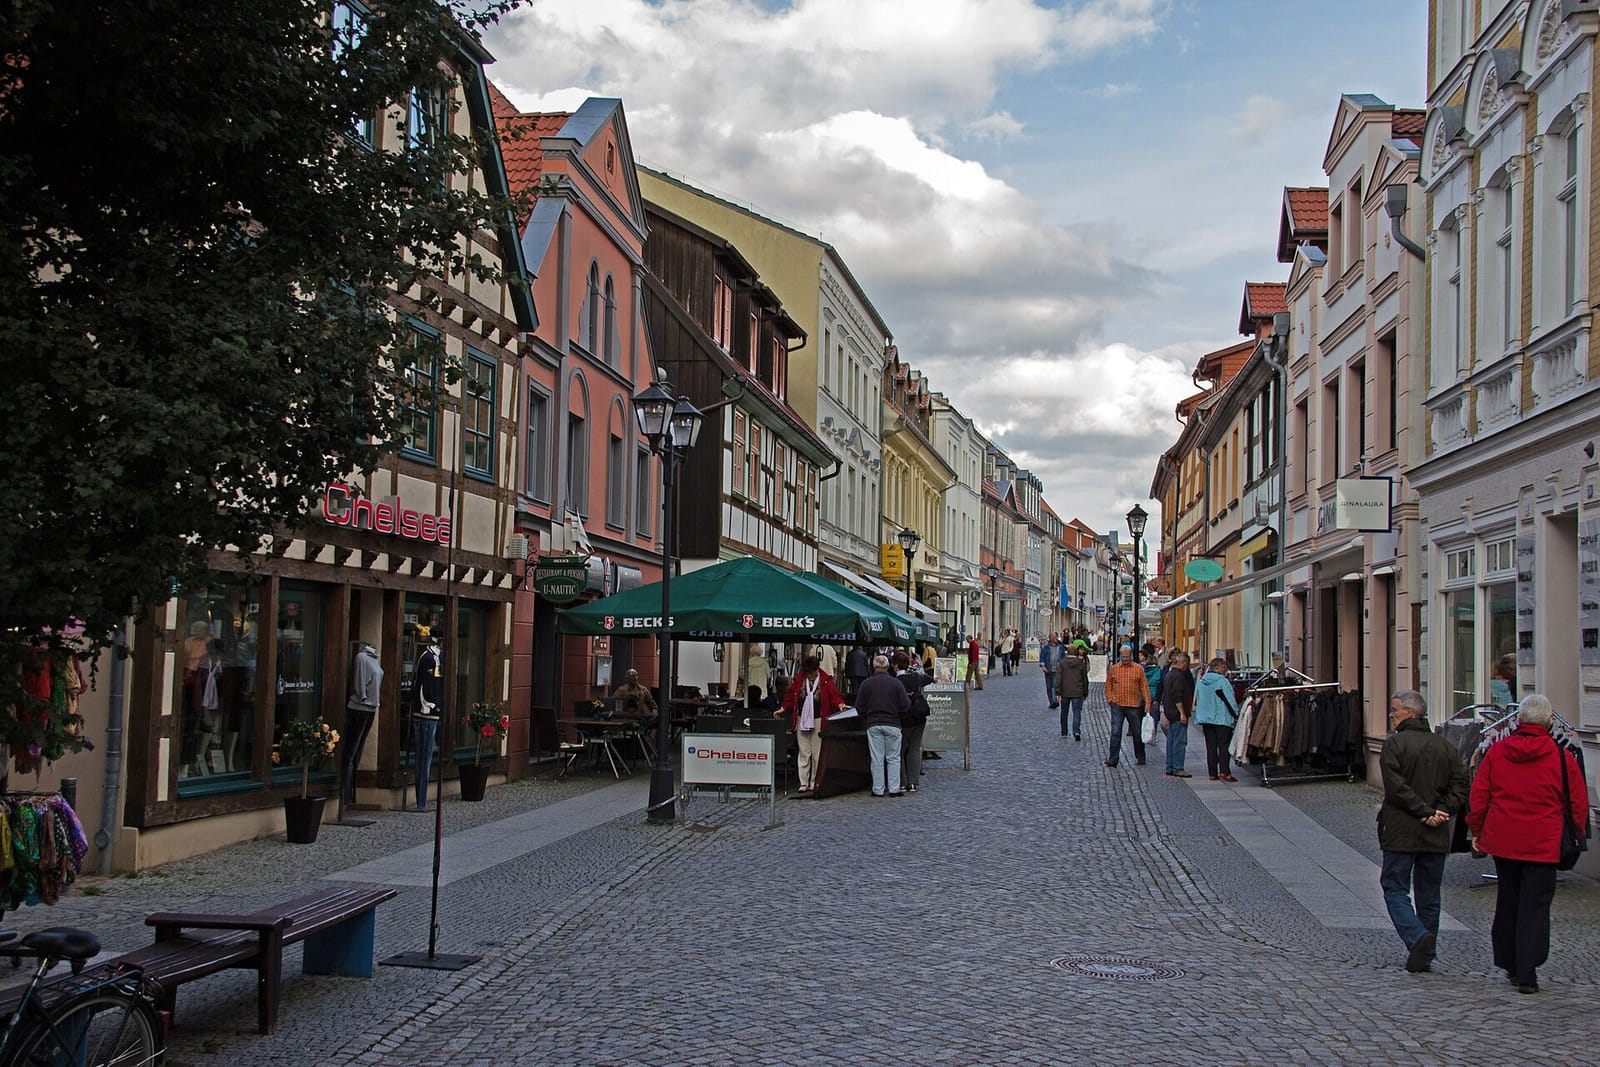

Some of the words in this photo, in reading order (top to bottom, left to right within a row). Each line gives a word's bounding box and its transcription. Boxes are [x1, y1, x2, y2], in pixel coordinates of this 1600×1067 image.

[323, 481, 451, 545] Chelsea
[543, 584, 576, 595] U-NAUTIC
[622, 616, 674, 628] BECKS
[761, 616, 815, 628] BECK'S
[697, 749, 768, 760] Chelsea
